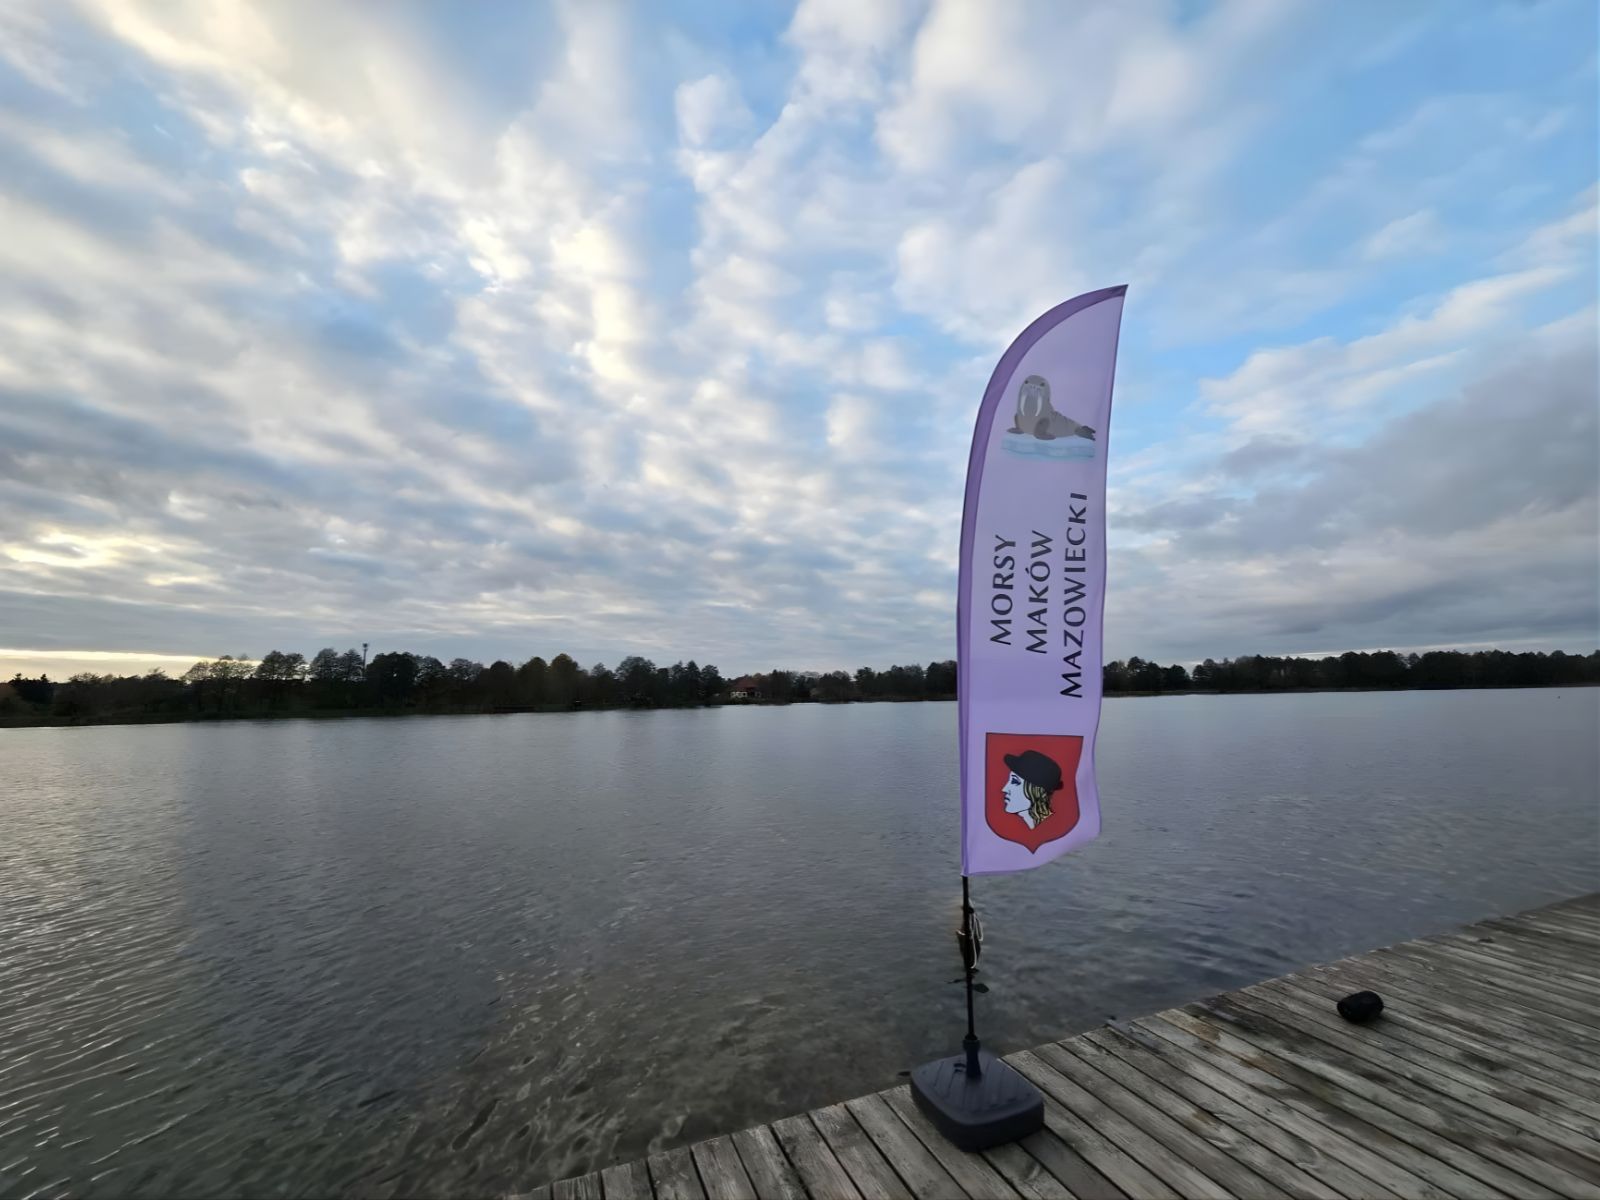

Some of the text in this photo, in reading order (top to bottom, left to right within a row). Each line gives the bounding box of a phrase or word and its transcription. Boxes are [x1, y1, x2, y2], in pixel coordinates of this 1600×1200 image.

[989, 534, 1016, 645] MORSY
[1025, 530, 1053, 654] MAKÓW
[1059, 493, 1087, 698] MAZOWIECKI
